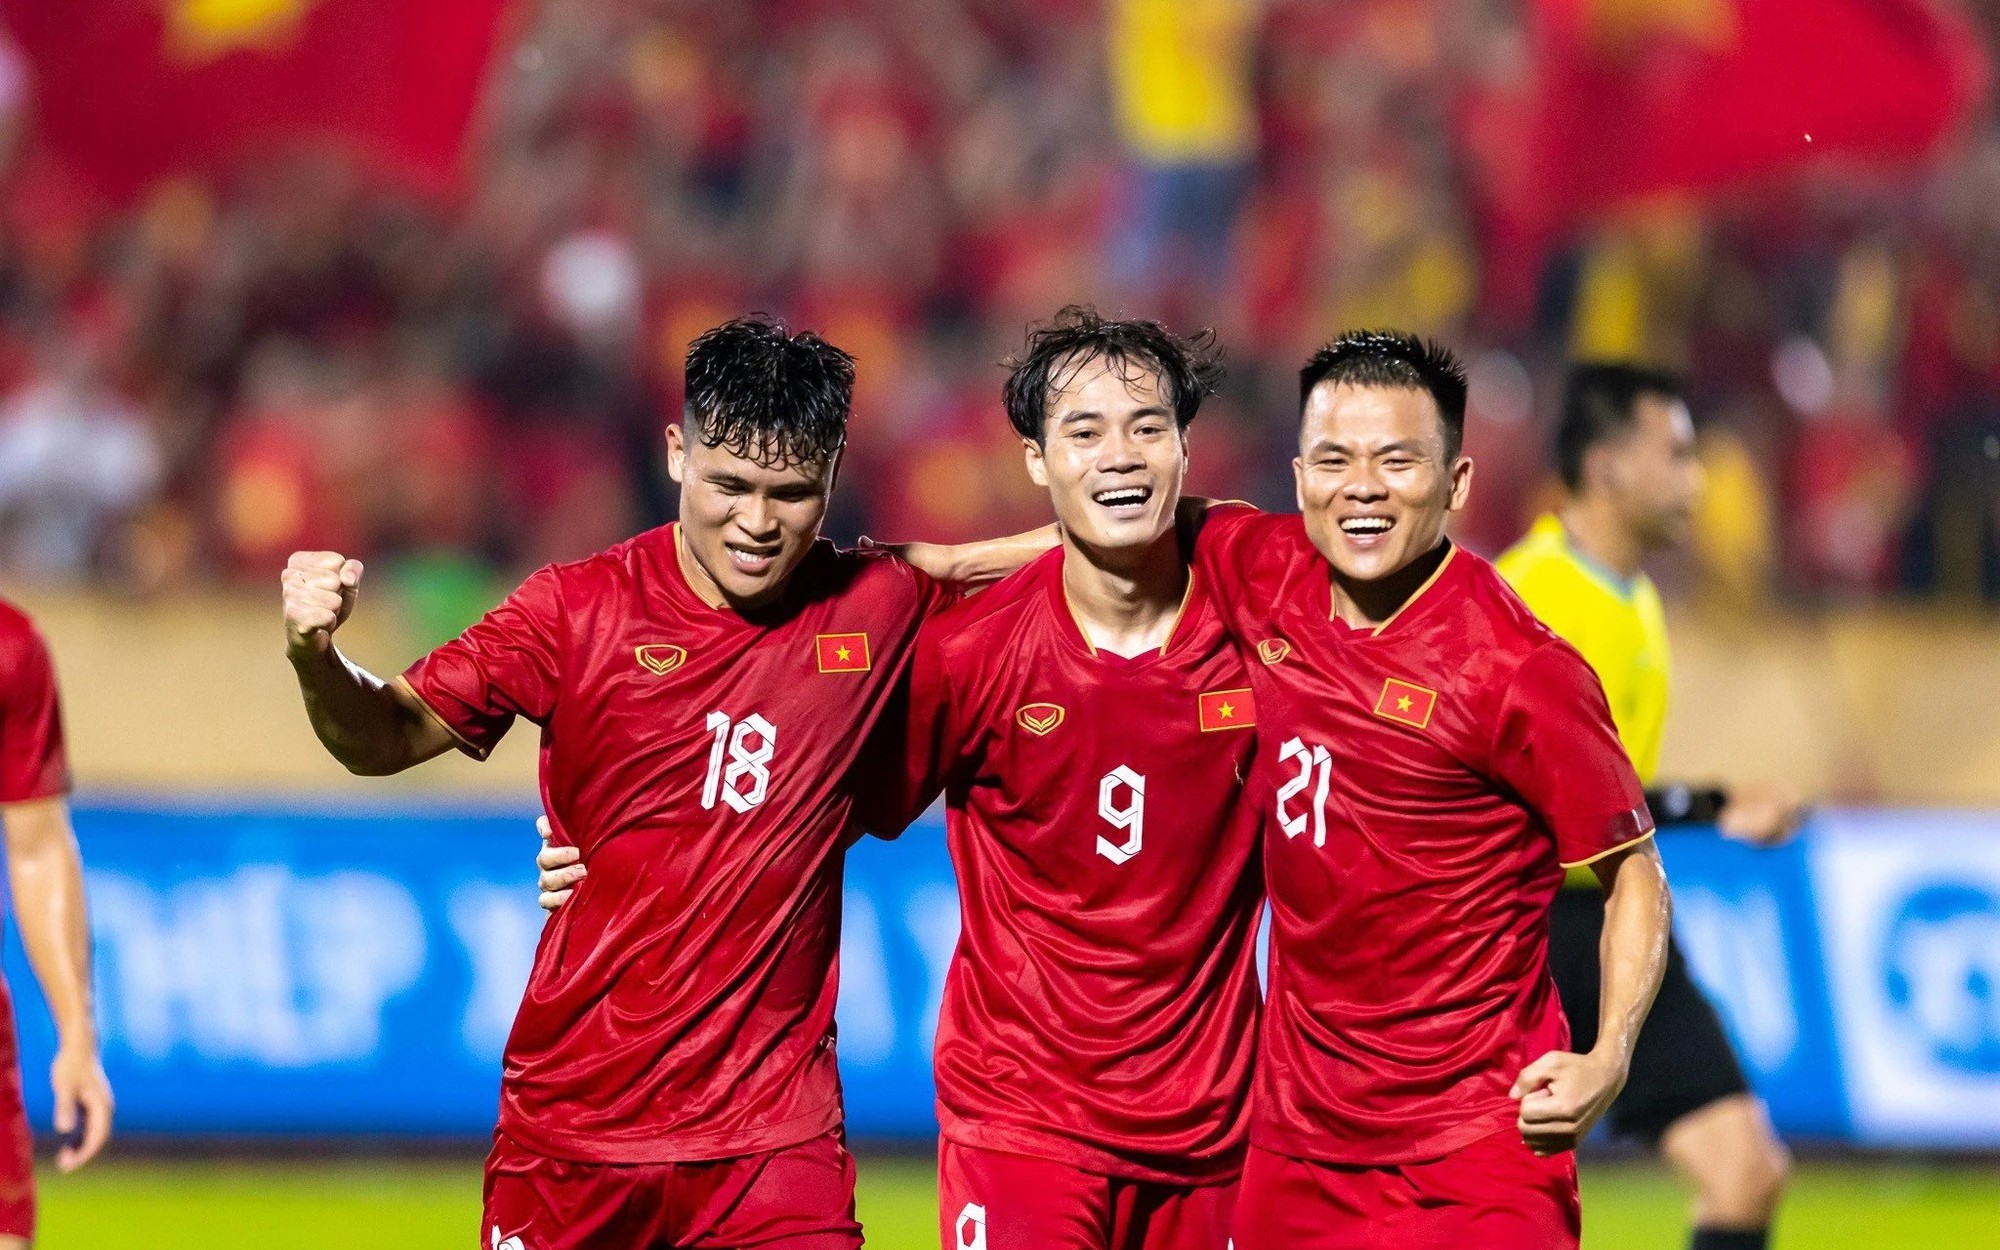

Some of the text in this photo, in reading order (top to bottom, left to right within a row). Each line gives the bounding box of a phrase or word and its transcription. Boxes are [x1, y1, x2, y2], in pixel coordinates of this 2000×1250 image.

[700, 710, 777, 814] 18
[1276, 736, 1332, 848] 21
[1096, 764, 1146, 865] 9
